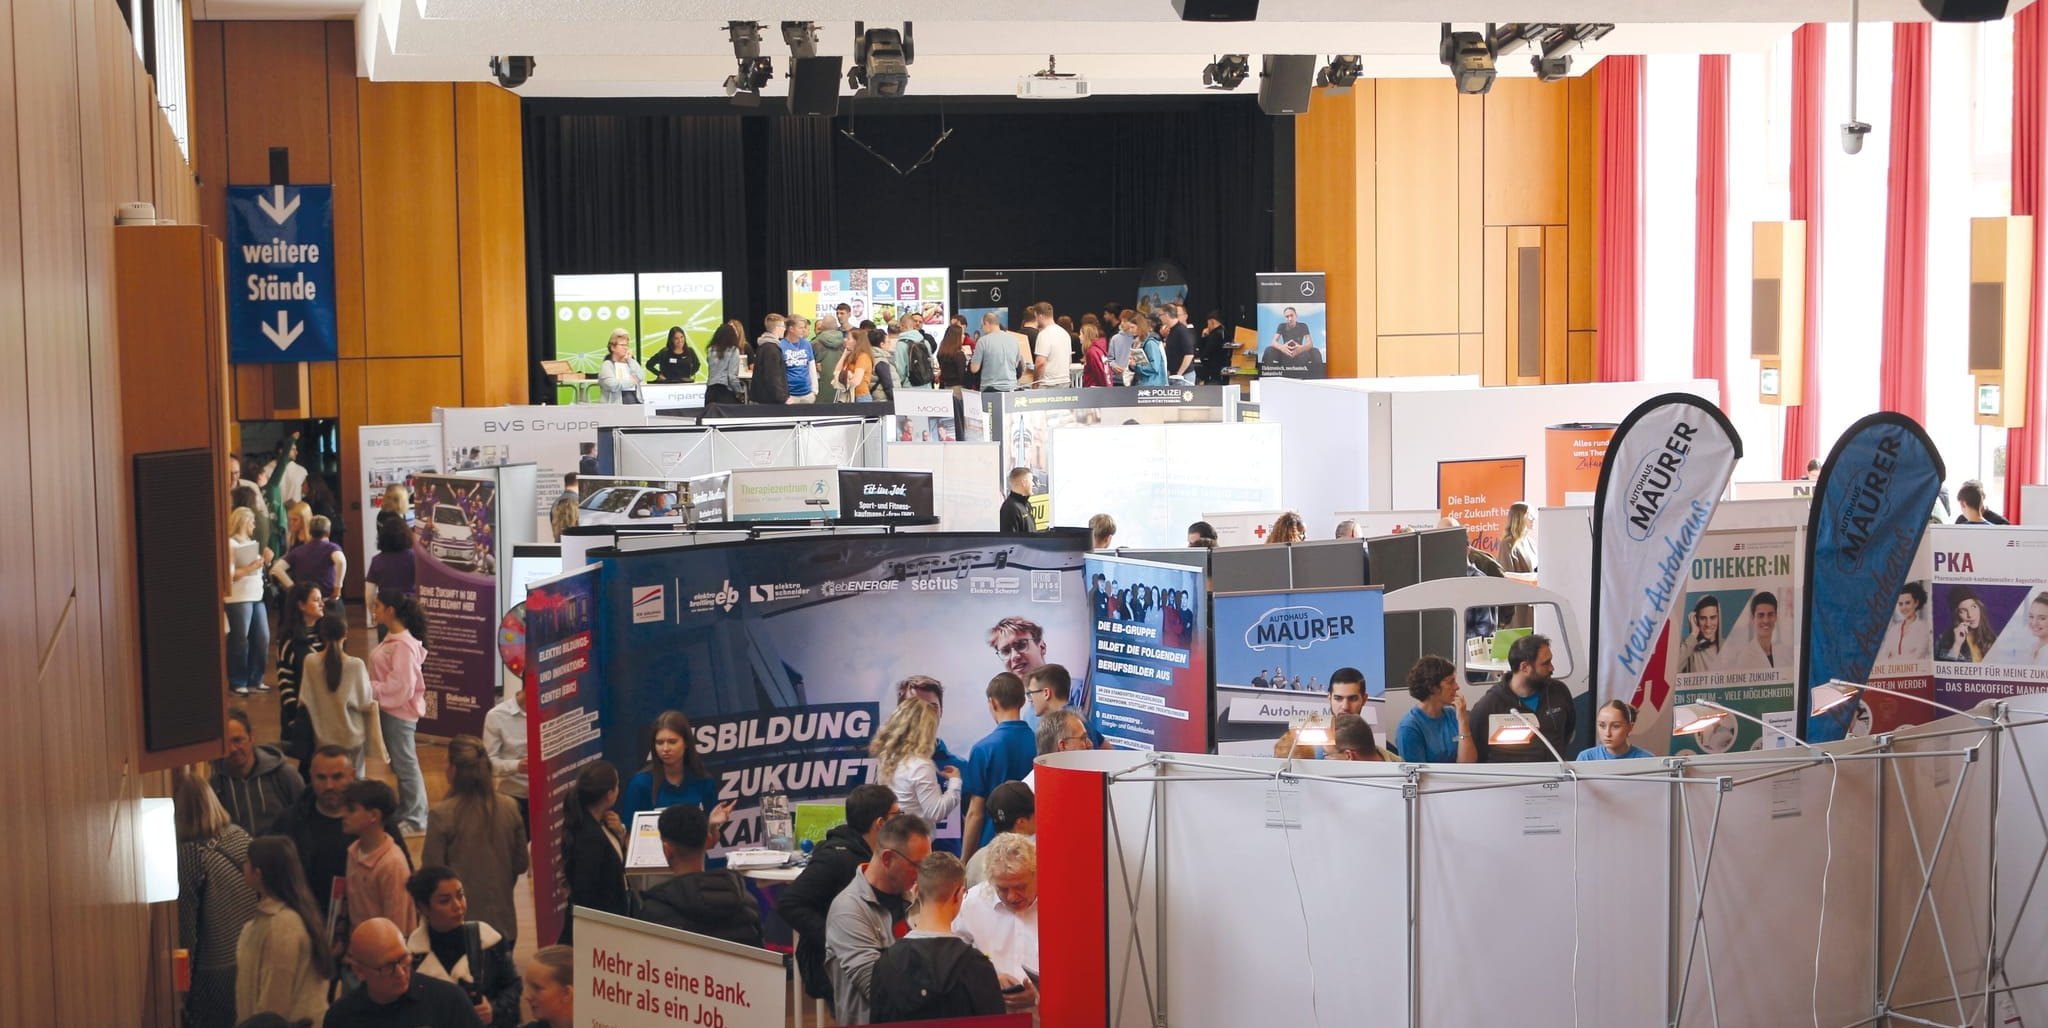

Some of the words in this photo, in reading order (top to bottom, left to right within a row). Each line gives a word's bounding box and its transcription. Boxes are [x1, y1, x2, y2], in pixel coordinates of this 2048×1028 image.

[243, 238, 319, 263] weitere
[247, 272, 316, 301] Stände
[656, 283, 715, 296] riparo
[1152, 389, 1182, 397] POLIZEI
[484, 419, 525, 433] BVS
[531, 418, 600, 433] Gruppe
[367, 439, 390, 447] BVS
[1573, 439, 1592, 447] Alles
[1590, 449, 1607, 457] The
[1630, 421, 1698, 531] MAURER
[741, 484, 808, 496] Therapiezentrum
[864, 484, 876, 495] Fit
[1630, 463, 1653, 506] AUTOHAUS
[1448, 496, 1461, 505] Die
[1464, 495, 1487, 505] Bank
[1841, 435, 1901, 562] MAURER
[1448, 510, 1463, 519] der
[1464, 508, 1499, 519] Zukunft
[1839, 485, 1862, 534] AUTOHAUS
[1464, 522, 1499, 532] Gesicht:
[1692, 554, 1791, 580] OTHEKER:IN
[1933, 551, 1974, 573] PKA
[834, 579, 899, 593] ebENERGIE
[911, 577, 959, 591] sectus
[694, 592, 716, 601] elektro
[774, 588, 811, 597] schneider
[1269, 612, 1308, 623] AUTOHAUS
[1097, 620, 1111, 632] DIE
[1112, 623, 1157, 639] EB-GRUPPE
[1257, 615, 1355, 645] MAURER
[1618, 611, 1657, 676] Mein
[1097, 640, 1125, 654] BILDET
[1126, 644, 1140, 656] DIE
[1141, 646, 1187, 664] FOLGENDEN
[1097, 659, 1154, 678] BERUFSBILDER
[1155, 669, 1171, 681] AUS
[1887, 663, 1918, 674] ZUKUNFT
[1936, 665, 1952, 674] DAS
[1954, 665, 1982, 676] REZEPT
[1985, 664, 2000, 677] FÜR
[2003, 668, 2027, 679] MEINE
[1683, 675, 1708, 687] REZEPT
[1710, 673, 1724, 685] FÜR
[1726, 673, 1747, 683] MEINE
[1748, 671, 1780, 681] ZUKUNFT
[1897, 679, 1927, 690] WERDEN
[1724, 690, 1741, 701] VIELE
[1742, 685, 1793, 700] MÖGLICHKEITEN
[1945, 682, 1962, 693] DAS
[1964, 682, 2014, 696] BACKOFFICE
[2016, 684, 2048, 696] MANAG
[691, 710, 871, 754] SBILDUNG
[718, 757, 880, 800] ZUKUNFT
[592, 947, 633, 977] Mehr
[636, 959, 660, 985] als
[664, 966, 699, 995] eine
[704, 975, 751, 1008] Bank.
[592, 976, 633, 1007] Mehr
[636, 989, 660, 1014] als
[664, 996, 689, 1022] ein
[693, 1003, 728, 1028] Job.
